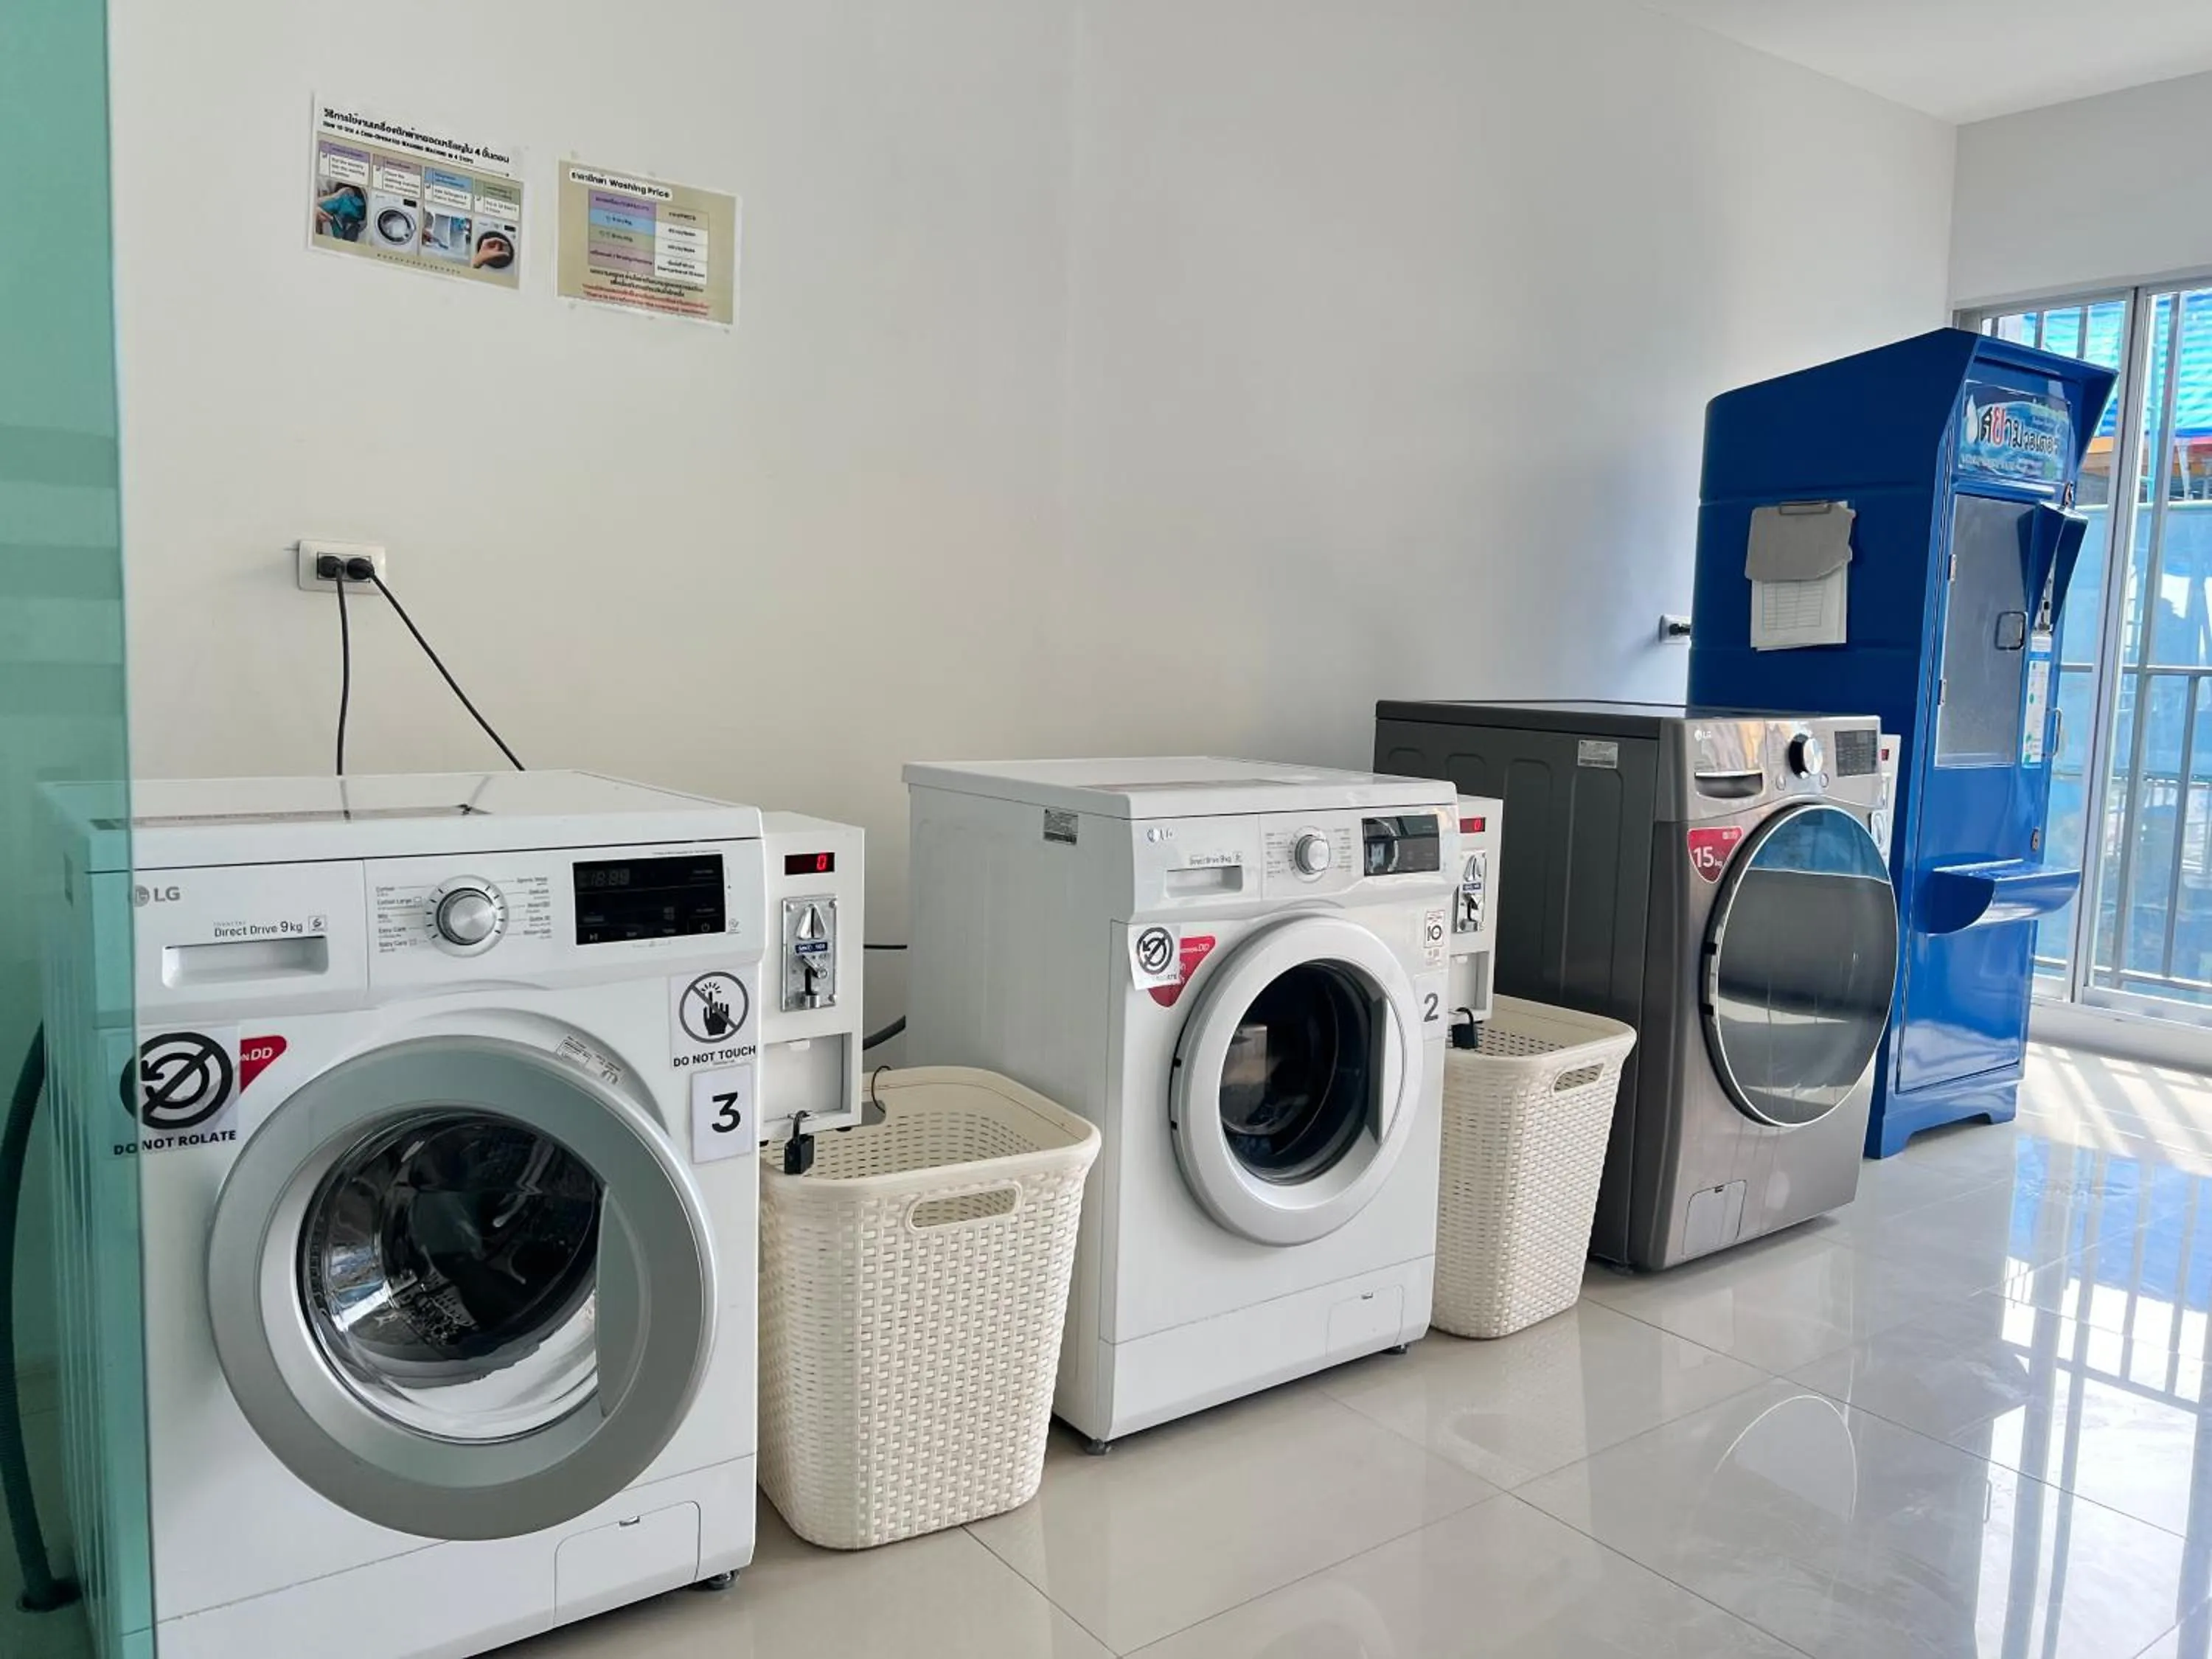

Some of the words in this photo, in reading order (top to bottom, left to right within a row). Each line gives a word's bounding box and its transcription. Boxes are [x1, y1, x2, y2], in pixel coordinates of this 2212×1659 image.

[474, 147, 481, 156] 4
[609, 178, 647, 195] Washing
[647, 187, 669, 198] Price
[816, 855, 827, 870] 0
[154, 886, 181, 902] LG
[215, 926, 247, 937] Direct
[250, 925, 277, 935] Drive
[1424, 992, 1439, 1022] 2
[673, 1056, 689, 1067] DO
[692, 1051, 715, 1064] NOT
[717, 1045, 756, 1060] TOUCH
[712, 1091, 741, 1133] 3
[114, 1144, 138, 1155] DO
[142, 1137, 174, 1150] NOT
[178, 1130, 236, 1147] ROLATE
